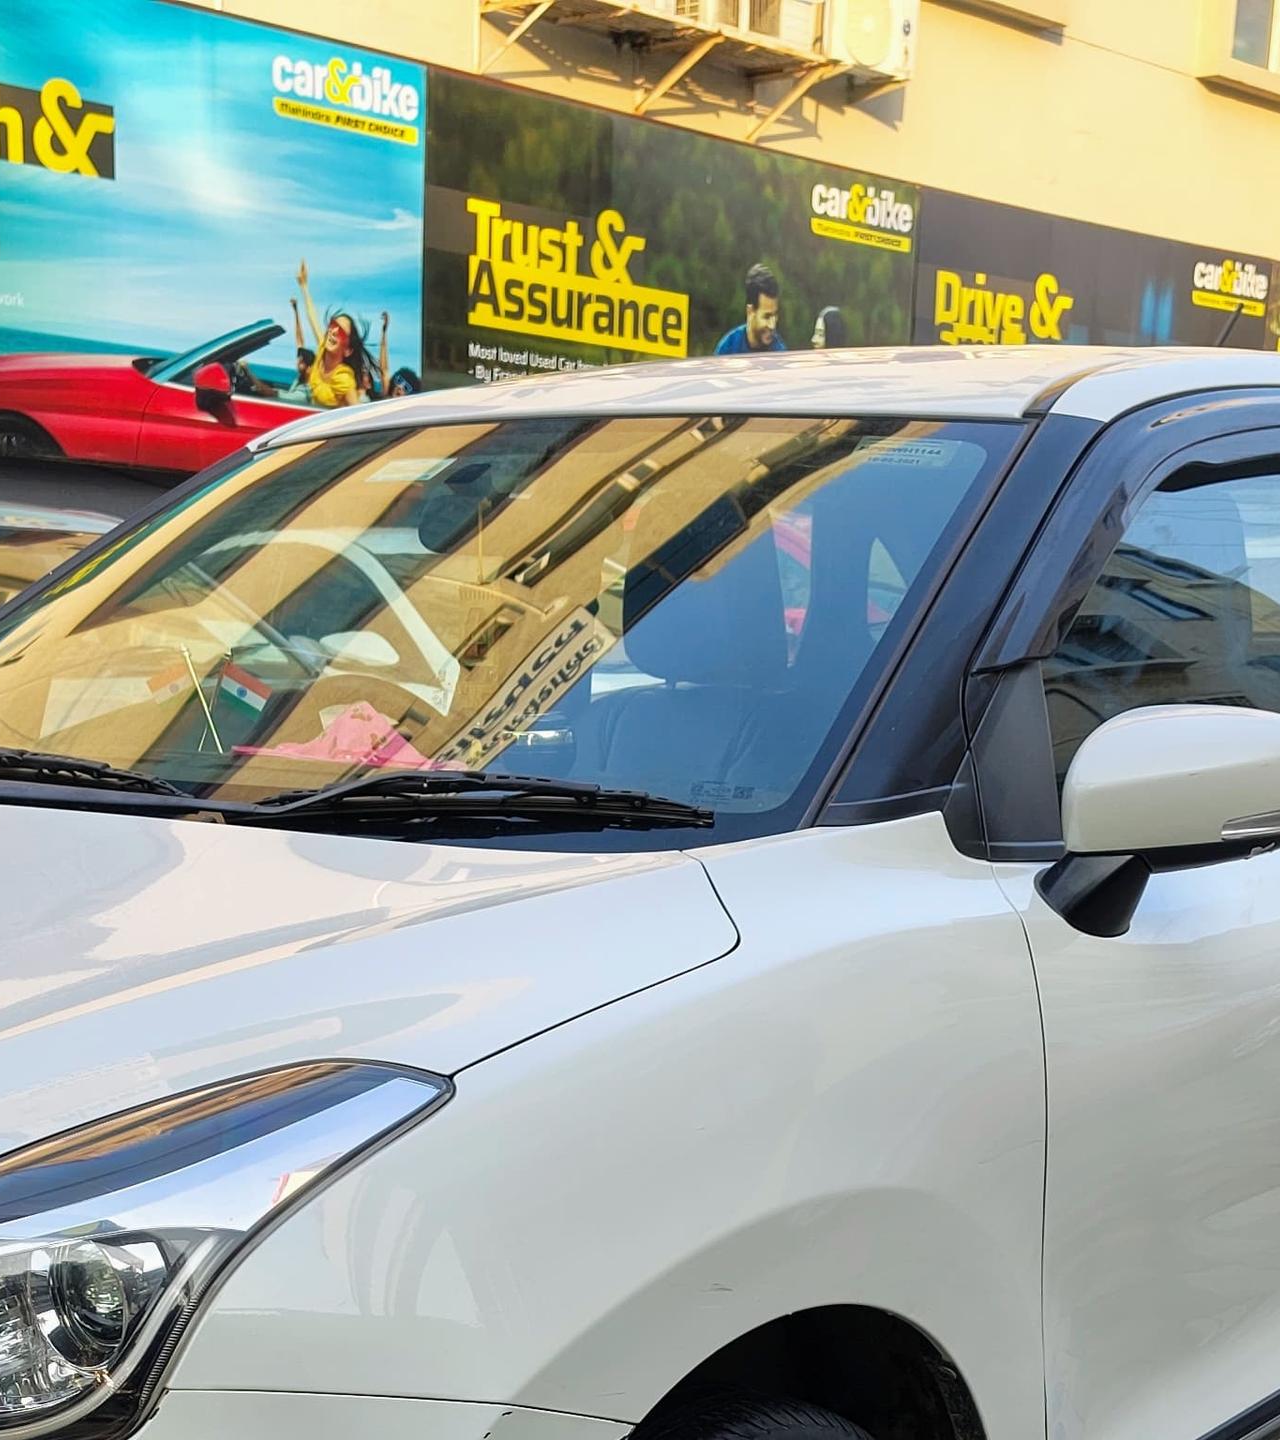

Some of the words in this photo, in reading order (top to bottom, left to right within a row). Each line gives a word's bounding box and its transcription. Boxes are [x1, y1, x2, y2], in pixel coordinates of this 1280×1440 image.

[271, 55, 419, 122] car&bike
[32, 77, 115, 178] &
[466, 197, 584, 276] Trust
[590, 209, 647, 286] &
[811, 183, 913, 233] car&bike
[470, 258, 683, 347] Assurance
[935, 270, 1025, 331] Drive
[1030, 273, 1074, 341] &
[468, 341, 497, 361] Most
[498, 346, 528, 366] loved
[529, 351, 557, 370] Used
